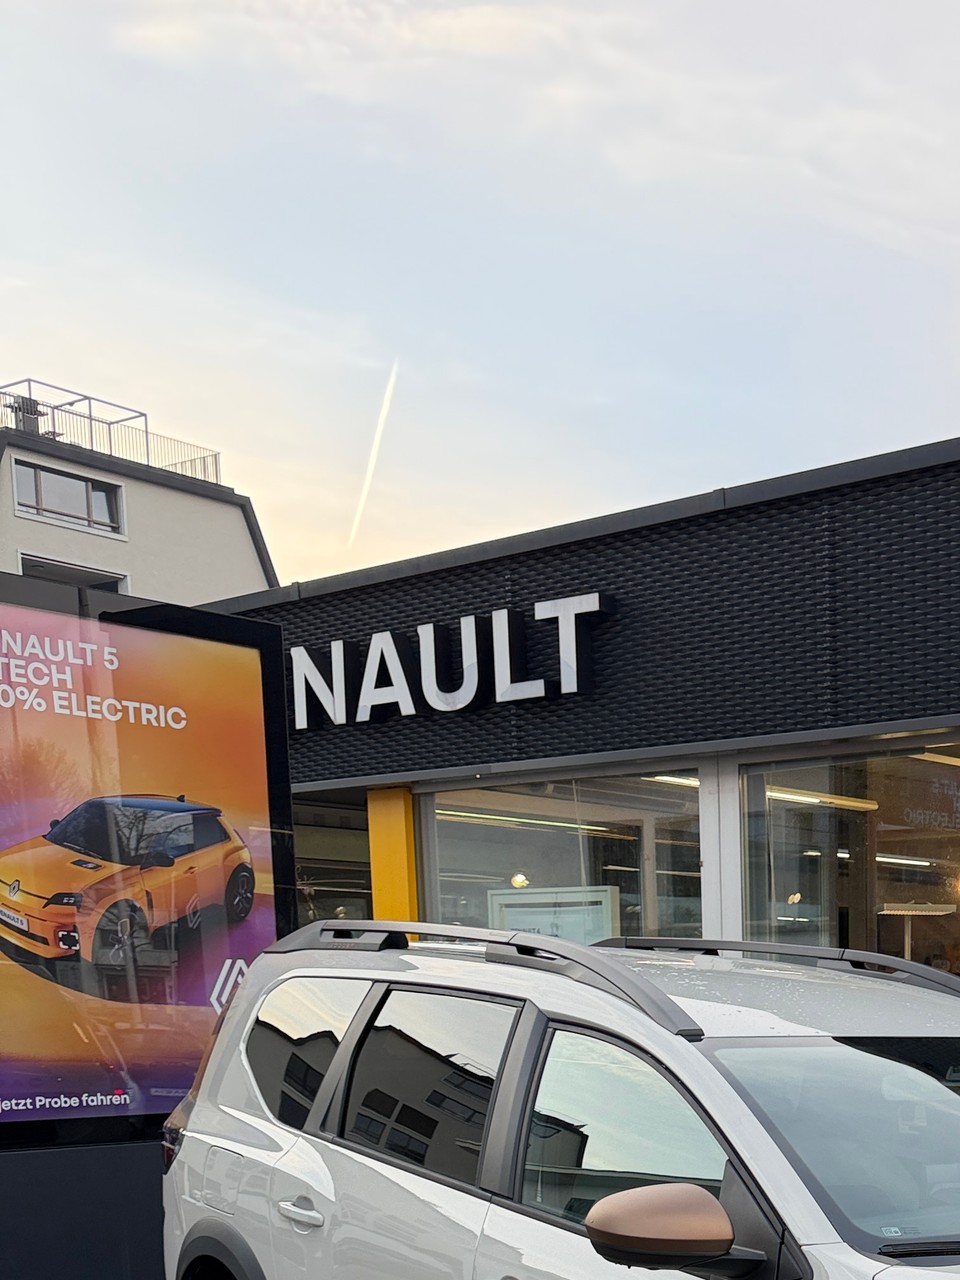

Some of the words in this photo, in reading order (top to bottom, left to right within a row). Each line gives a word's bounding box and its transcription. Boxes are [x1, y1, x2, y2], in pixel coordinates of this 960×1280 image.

[1, 629, 98, 667] NAULT
[103, 646, 119, 670] 5
[290, 592, 600, 730] NAULT
[53, 690, 187, 729] ELECTRIC
[35, 1095, 79, 1109] Probe
[81, 1092, 130, 1107] fahren
